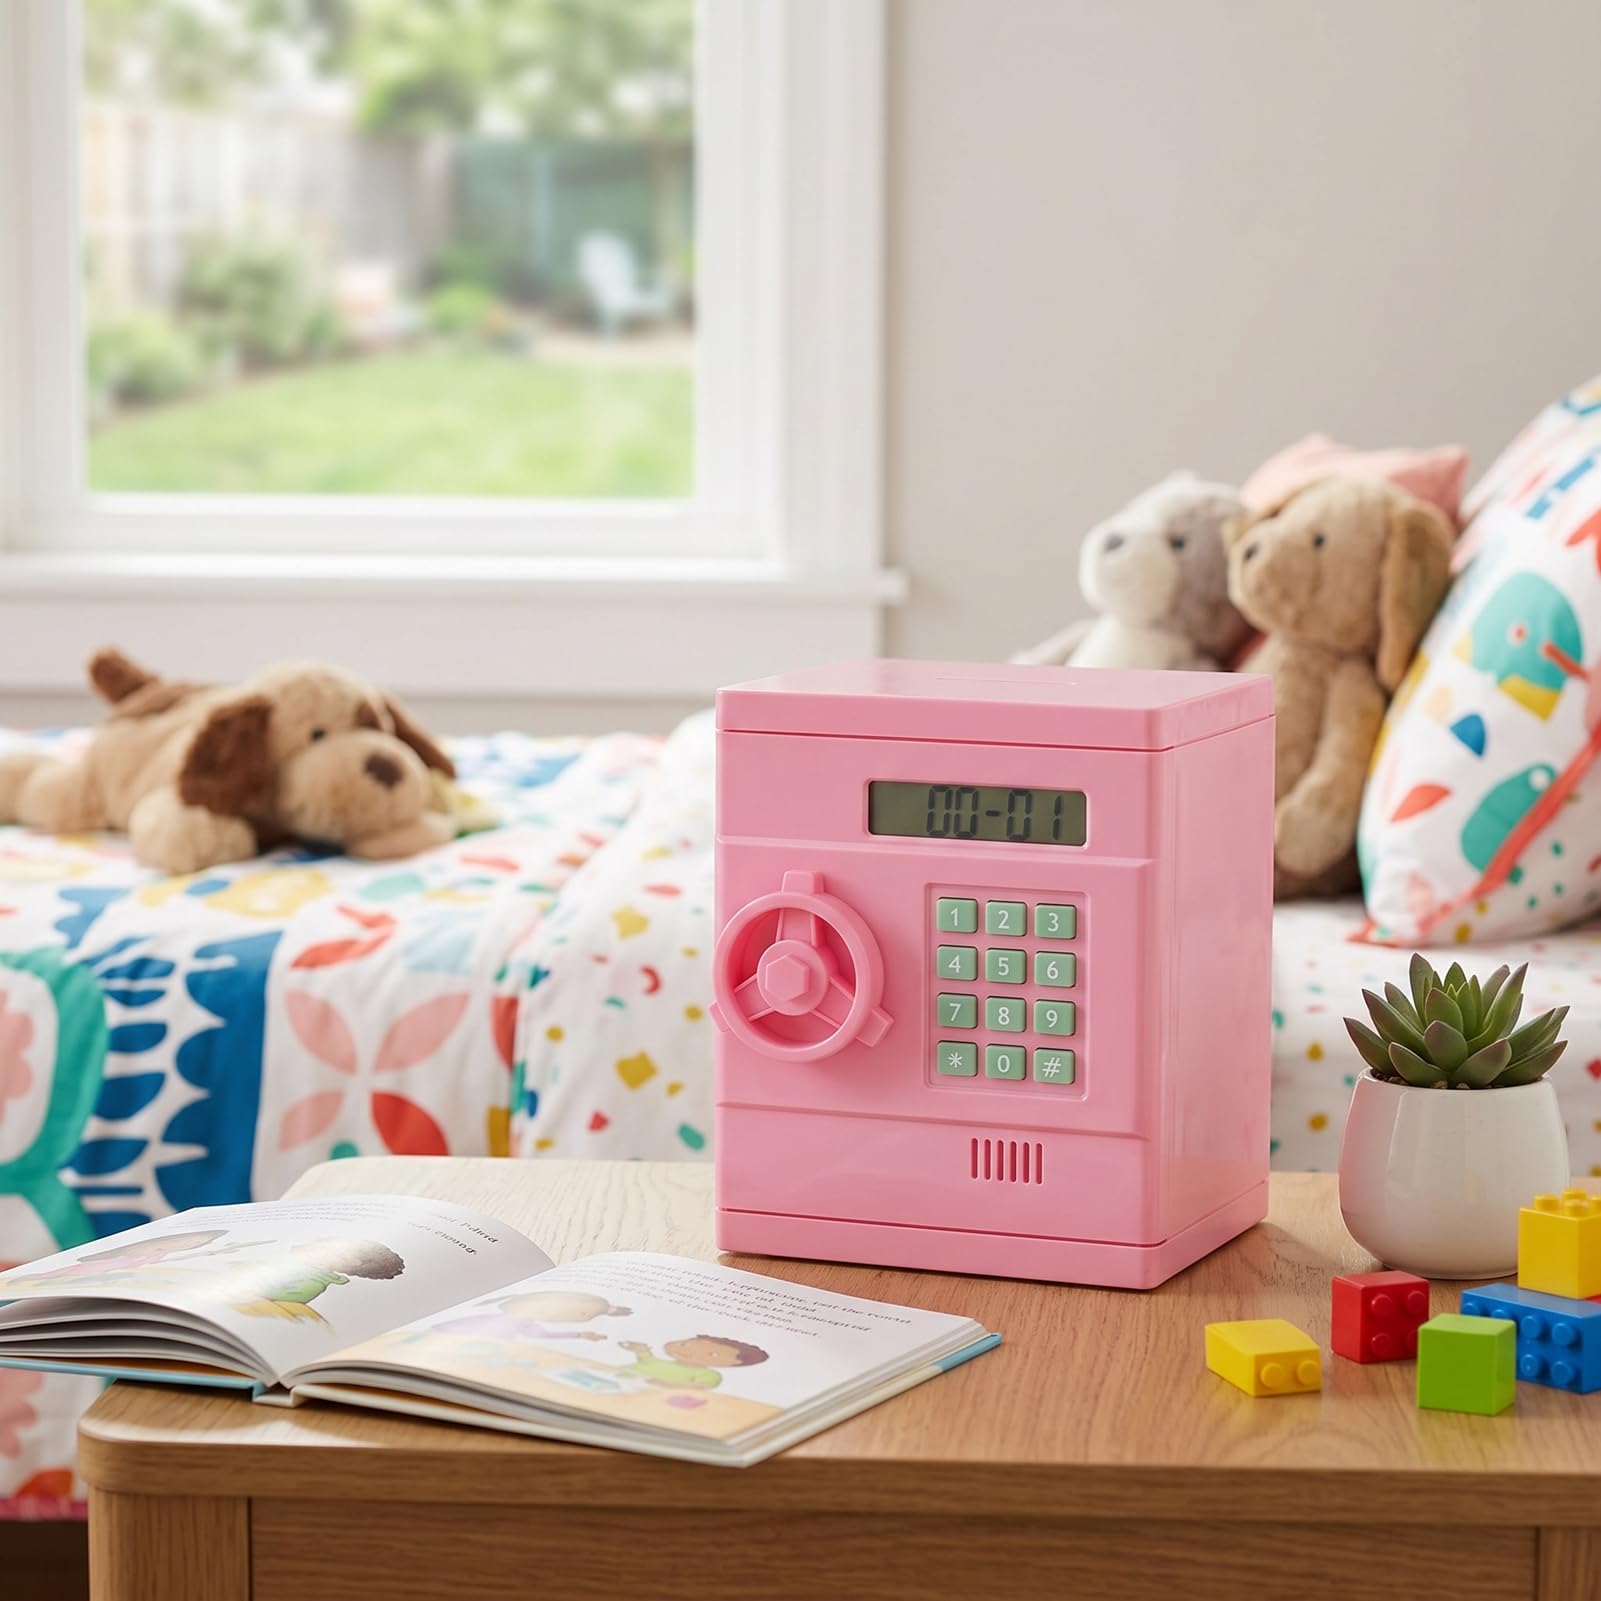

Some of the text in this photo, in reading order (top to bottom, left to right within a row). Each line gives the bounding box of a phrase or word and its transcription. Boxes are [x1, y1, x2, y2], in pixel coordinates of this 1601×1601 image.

[926, 785, 1064, 841] 00-01
[950, 907, 1059, 932] 1 2 3
[948, 954, 1059, 980] 4 5 6
[949, 1003, 1058, 1028] 7 8 9
[997, 1055, 1010, 1073] 0
[1042, 1056, 1062, 1078] #
